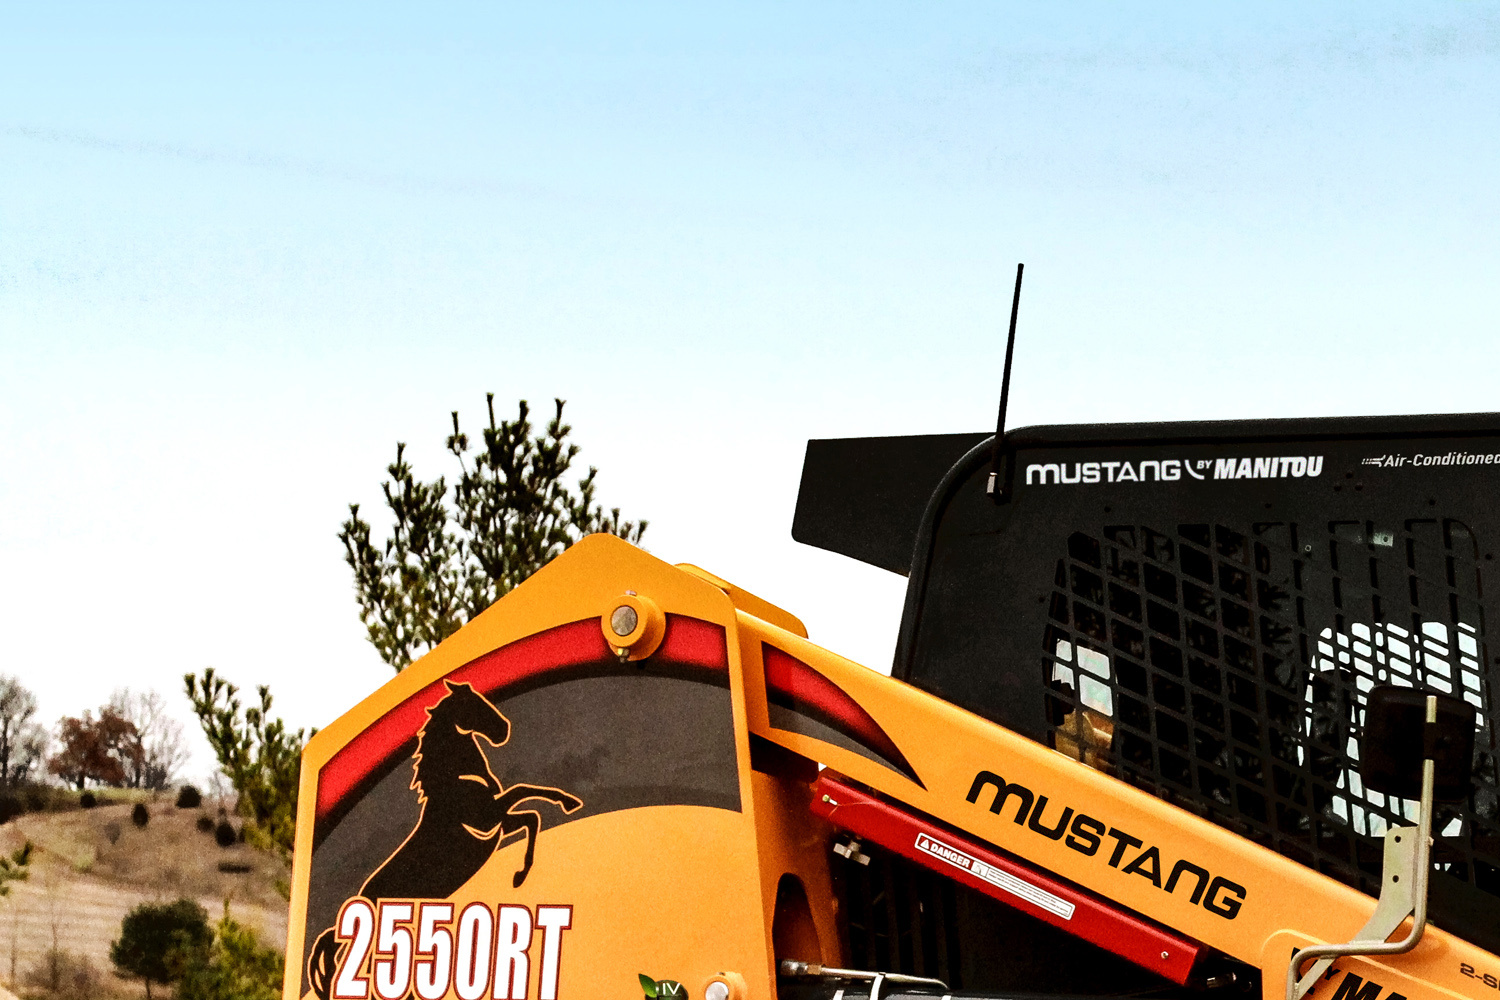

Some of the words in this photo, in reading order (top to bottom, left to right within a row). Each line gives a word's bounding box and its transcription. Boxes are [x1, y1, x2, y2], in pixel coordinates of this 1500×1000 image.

[1026, 460, 1181, 484] MUSTANG
[1196, 460, 1213, 470] BY
[1213, 456, 1324, 479] MANITOU
[930, 843, 971, 868] DANGER
[965, 770, 1247, 920] MUSTANG
